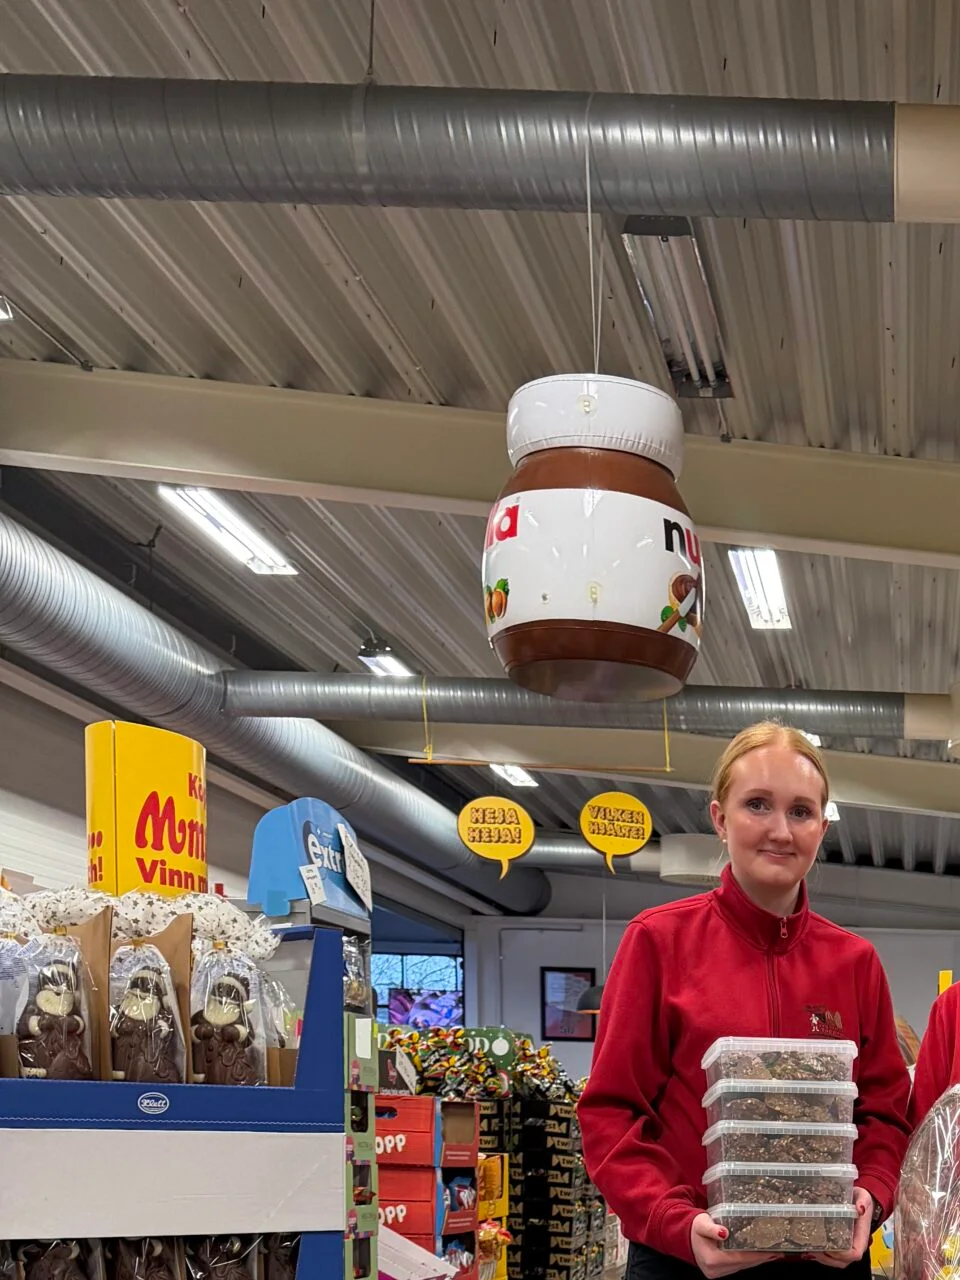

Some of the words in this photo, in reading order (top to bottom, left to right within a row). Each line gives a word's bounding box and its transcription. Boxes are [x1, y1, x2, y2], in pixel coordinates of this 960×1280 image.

[470, 807, 520, 825] HEJA
[588, 804, 645, 825] VILKEN
[467, 826, 522, 844] HEJA!
[588, 820, 646, 840] HJÄLTE!
[135, 856, 195, 892] Vinn
